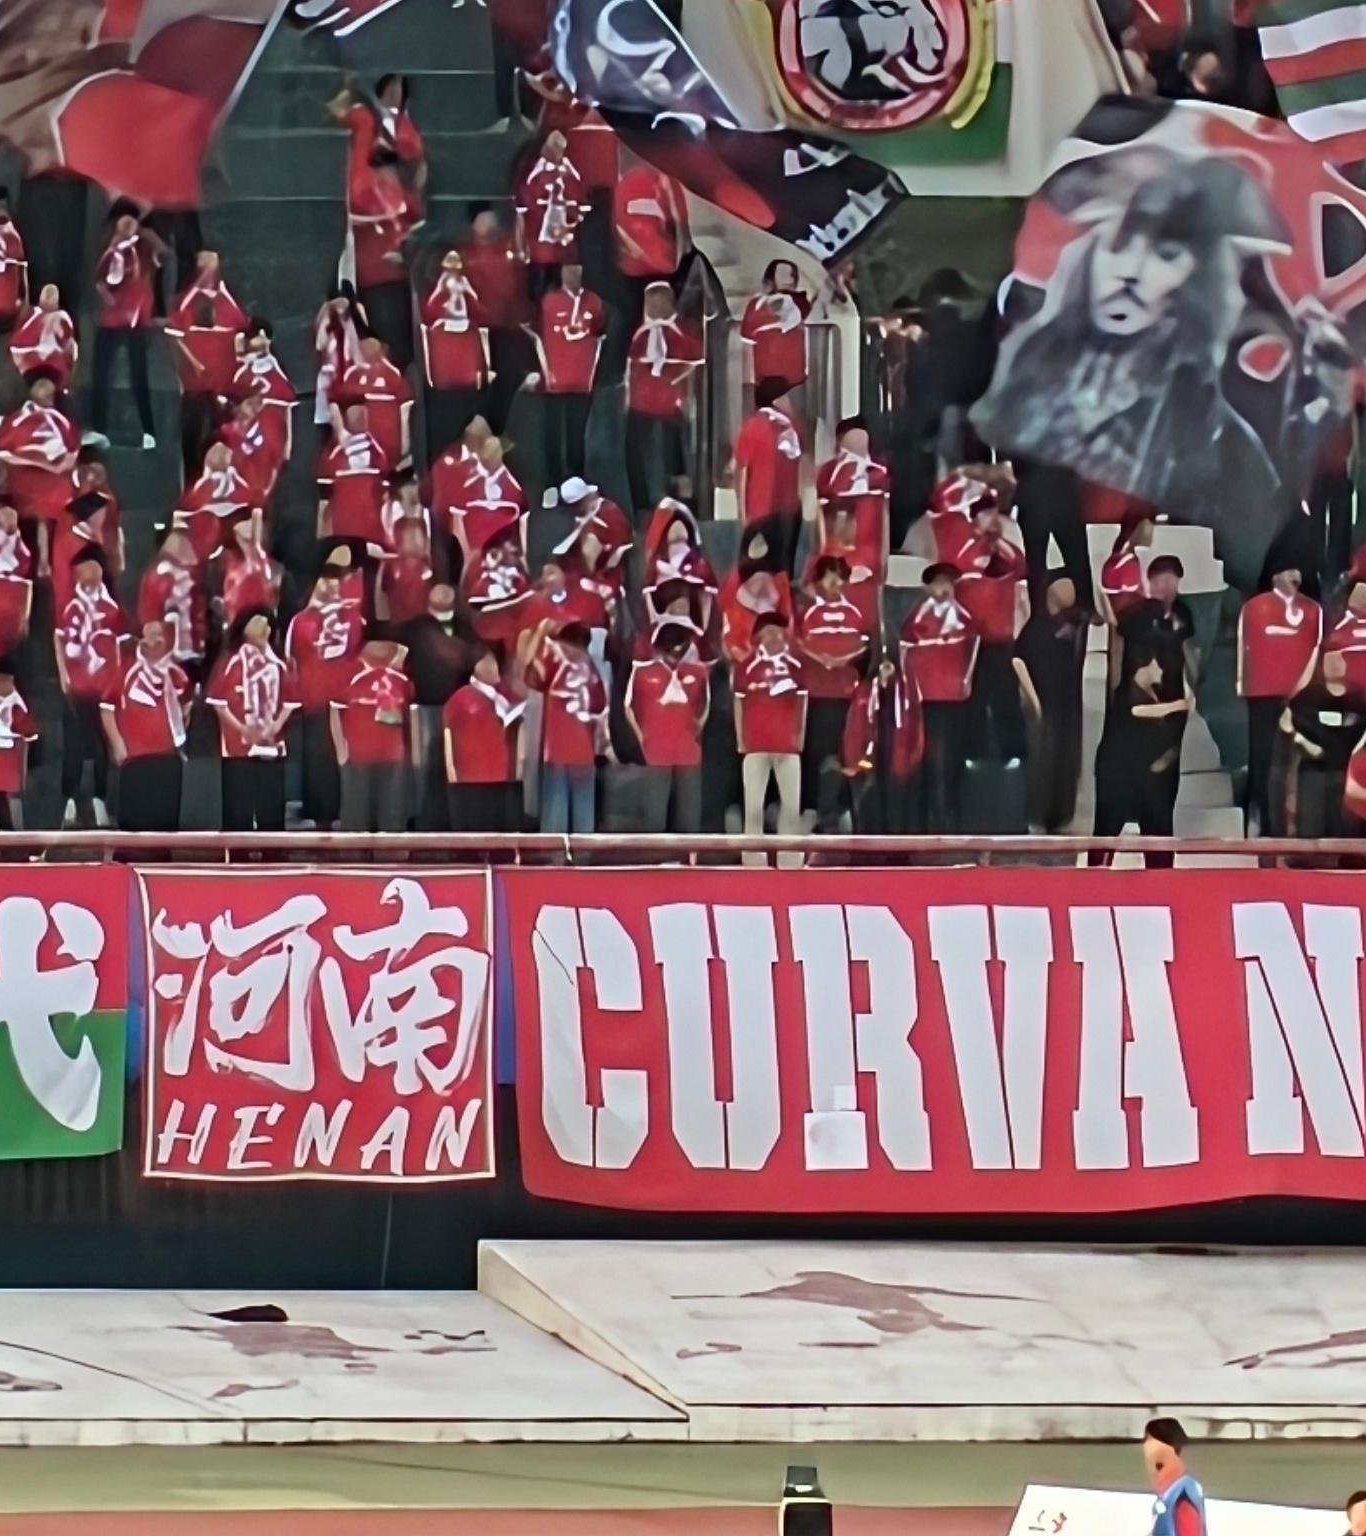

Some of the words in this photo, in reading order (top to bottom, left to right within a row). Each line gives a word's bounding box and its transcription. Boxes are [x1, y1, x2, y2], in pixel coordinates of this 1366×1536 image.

[151, 877, 490, 1096] 河南
[530, 901, 1201, 1173] CURVA
[156, 1097, 484, 1175] HENAN
